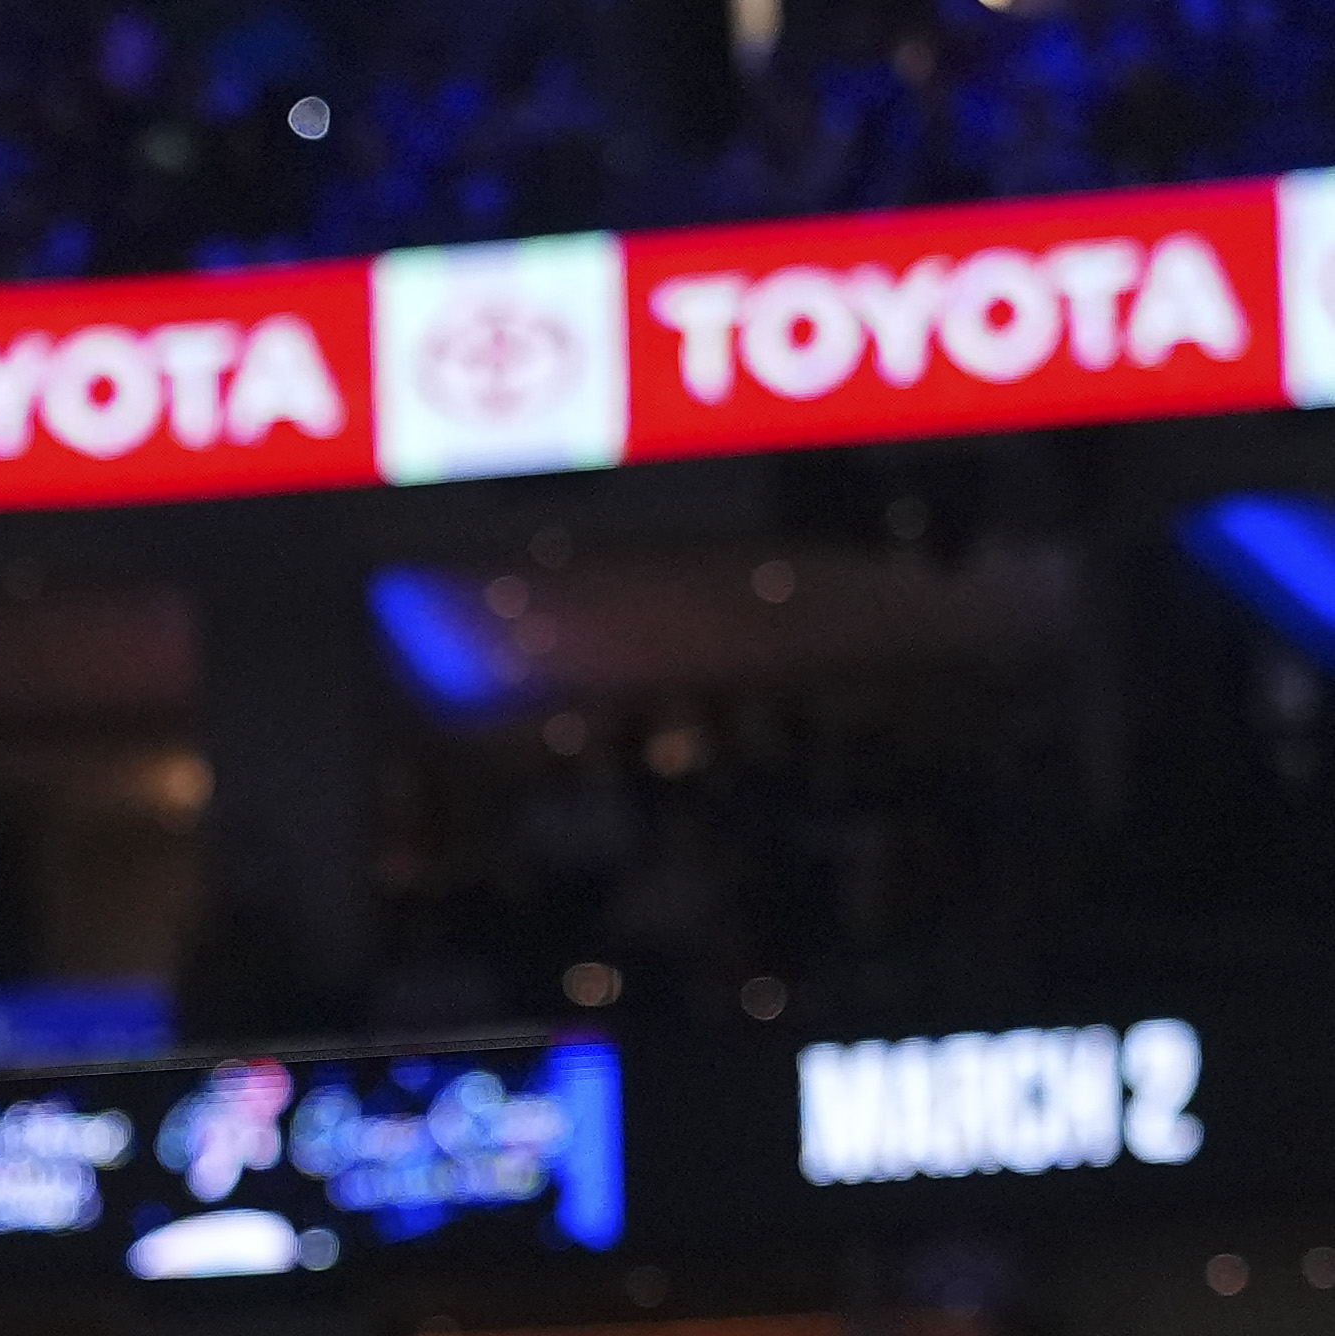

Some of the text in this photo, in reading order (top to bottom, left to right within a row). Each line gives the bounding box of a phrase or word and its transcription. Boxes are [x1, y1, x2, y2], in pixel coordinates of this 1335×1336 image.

[652, 231, 1247, 402] TOYOTA
[797, 1017, 1203, 1186] MARCH 2
